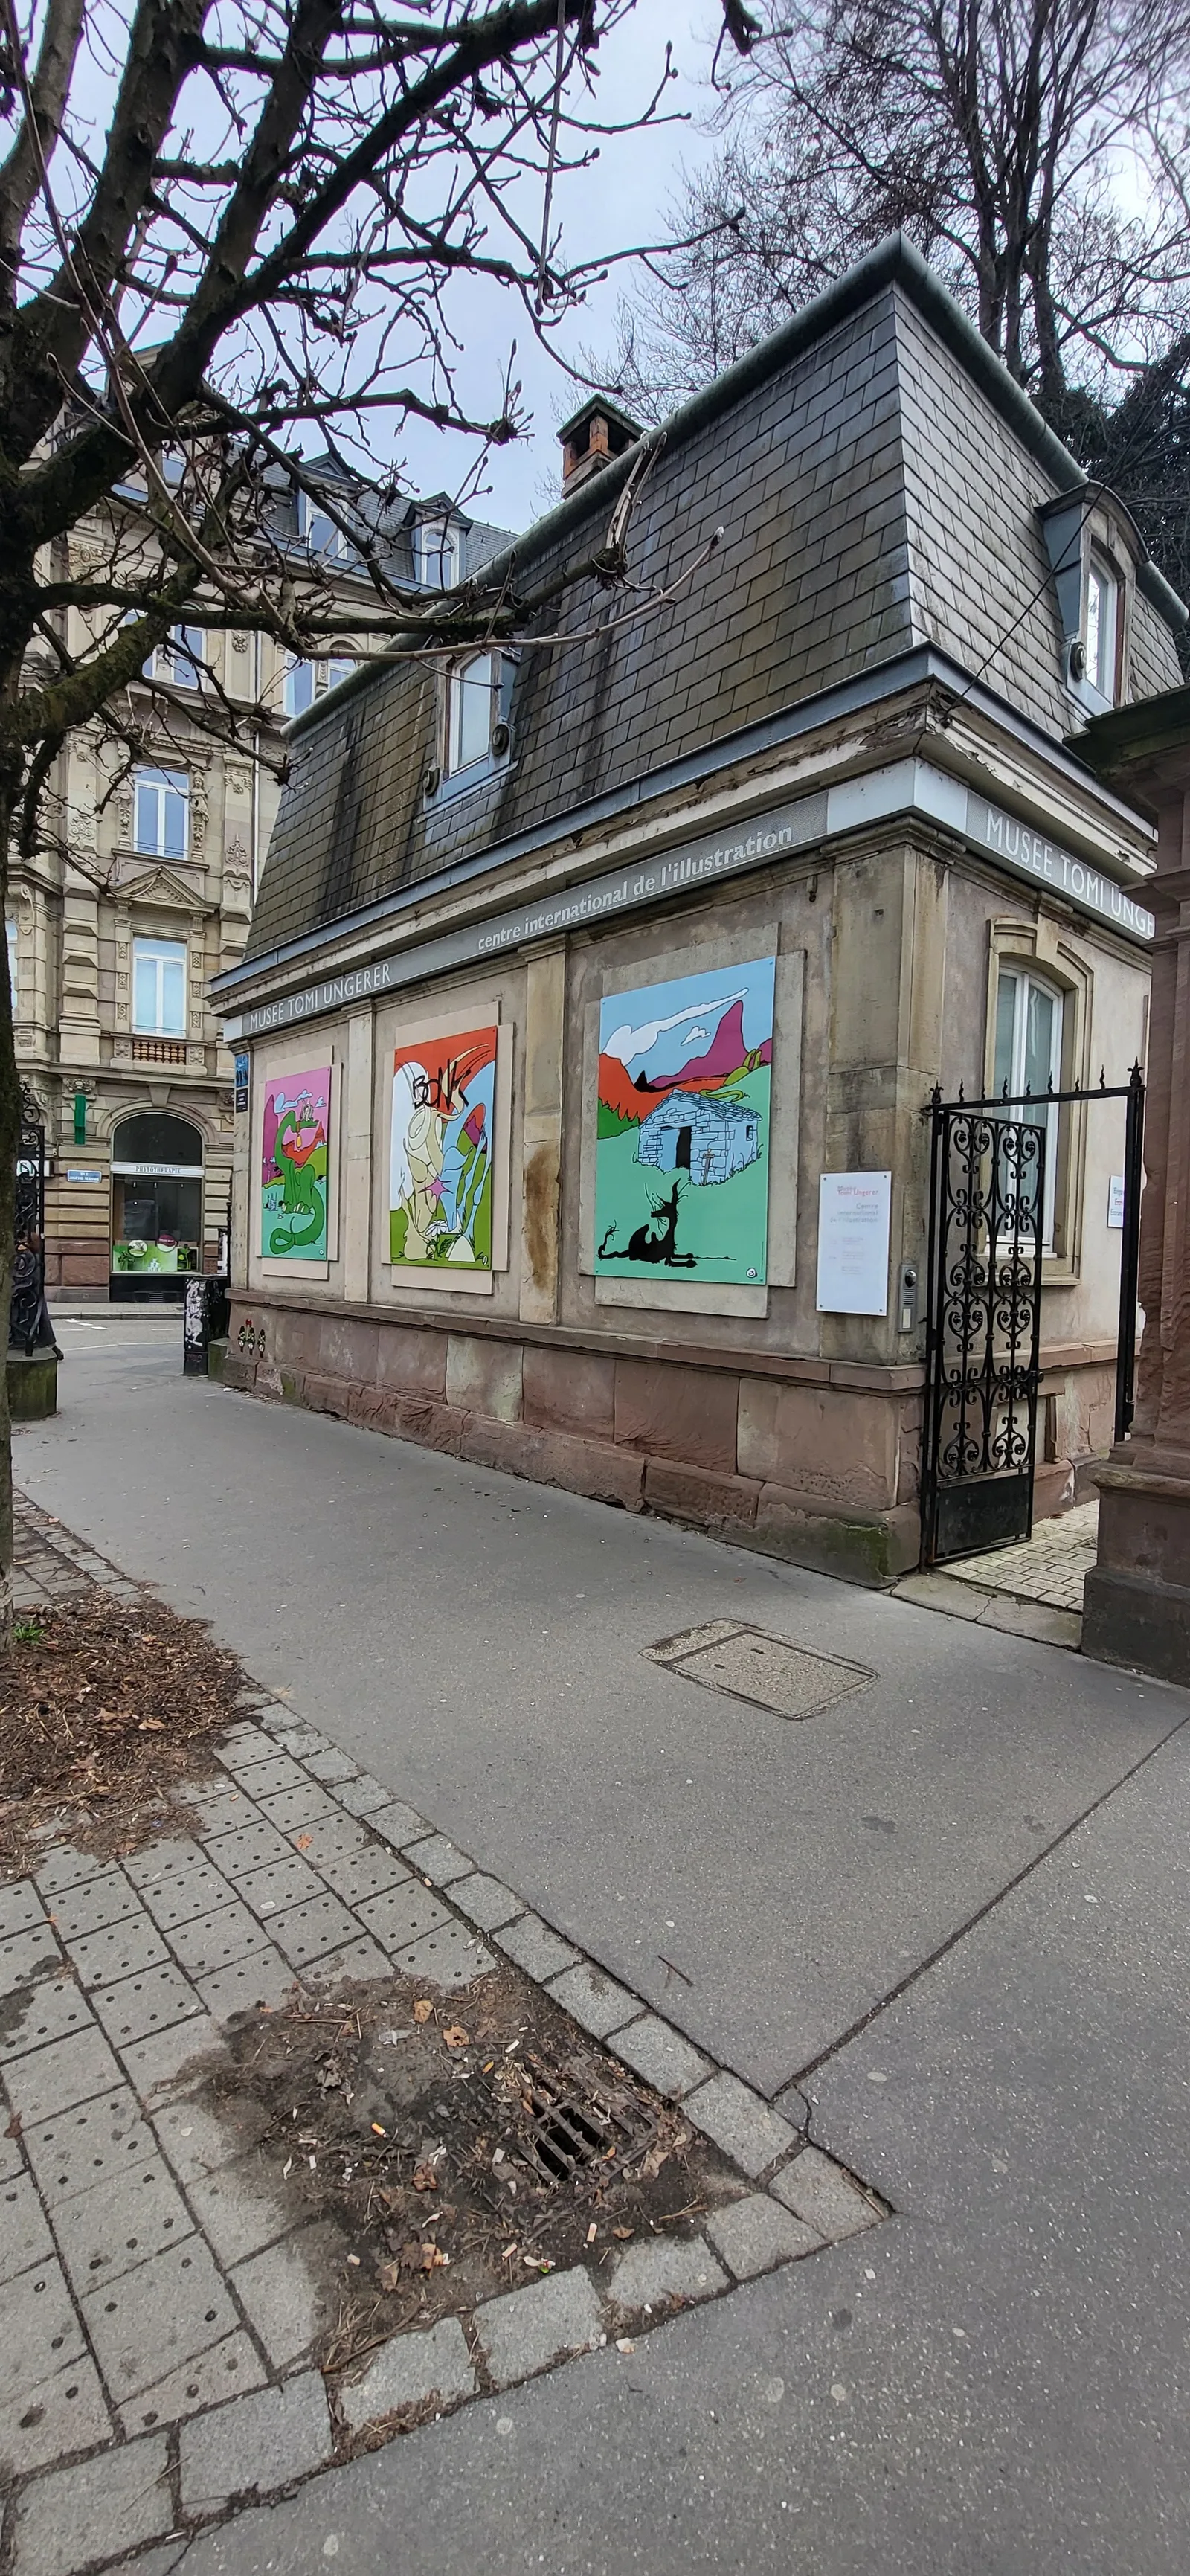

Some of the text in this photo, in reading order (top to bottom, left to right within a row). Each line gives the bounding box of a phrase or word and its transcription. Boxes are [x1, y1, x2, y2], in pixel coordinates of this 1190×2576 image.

[478, 826, 793, 951] centre international de l'illustration
[986, 809, 1053, 878] MUSEE
[1060, 854, 1104, 908] TOMI
[249, 963, 390, 1031] MUSEE TOMI UNGERER
[854, 1188, 878, 1197] Ungerer
